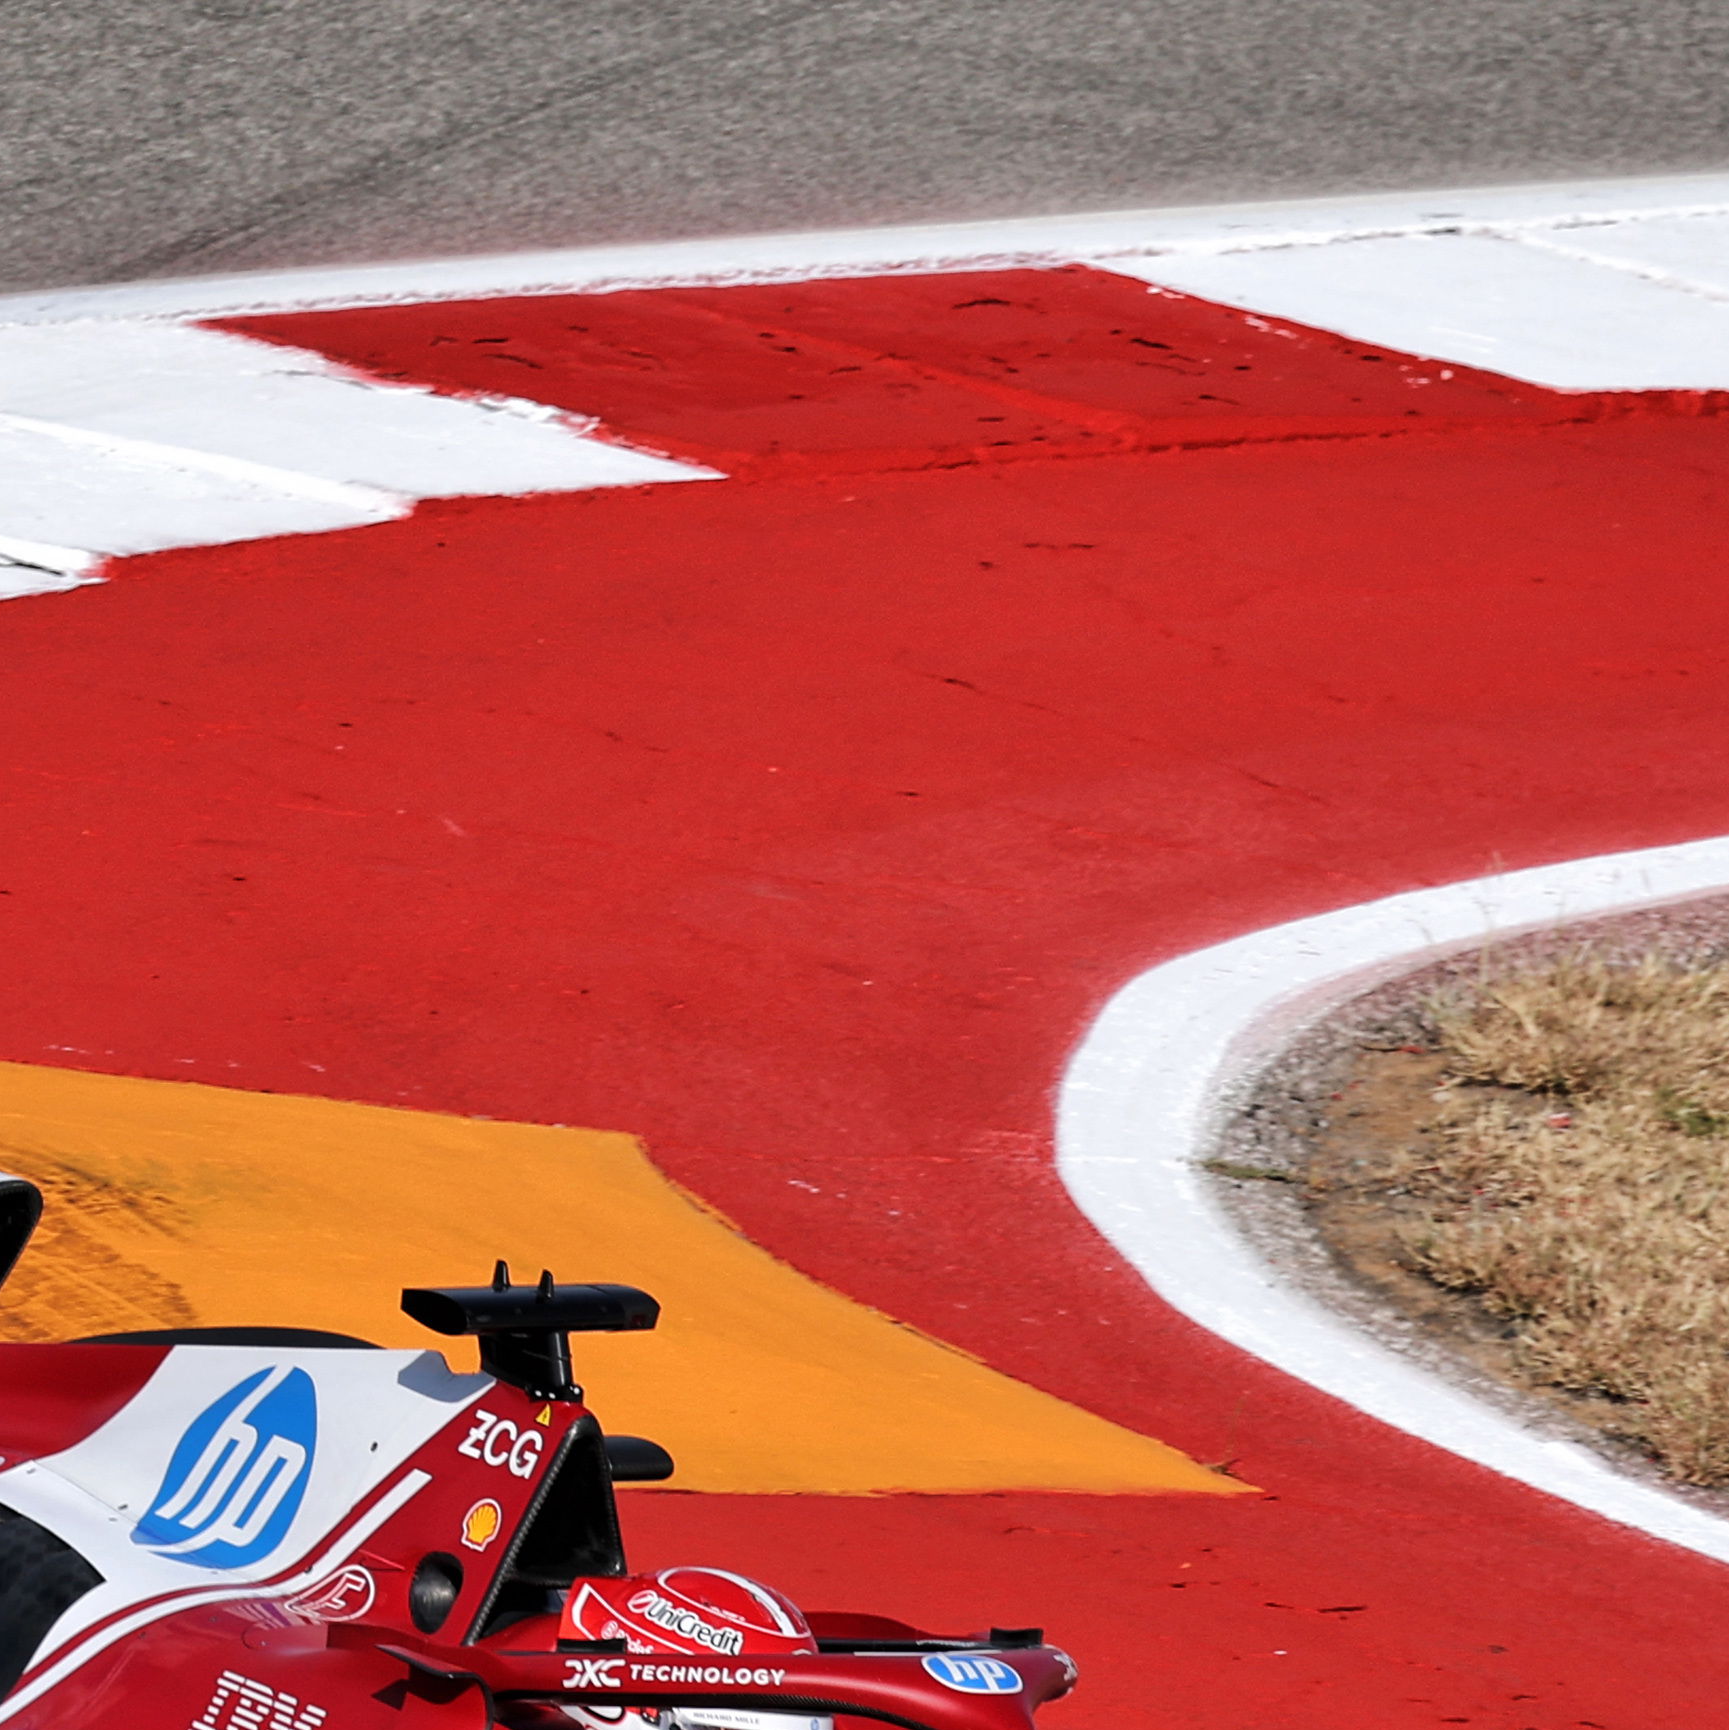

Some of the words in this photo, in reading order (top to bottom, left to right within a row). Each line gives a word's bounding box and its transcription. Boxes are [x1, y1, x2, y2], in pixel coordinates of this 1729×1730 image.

[132, 1366, 312, 1558] hp
[646, 1596, 743, 1655] UniCredit
[630, 1664, 785, 1686] TECHNOLOGY
[930, 1652, 1014, 1693] hp
